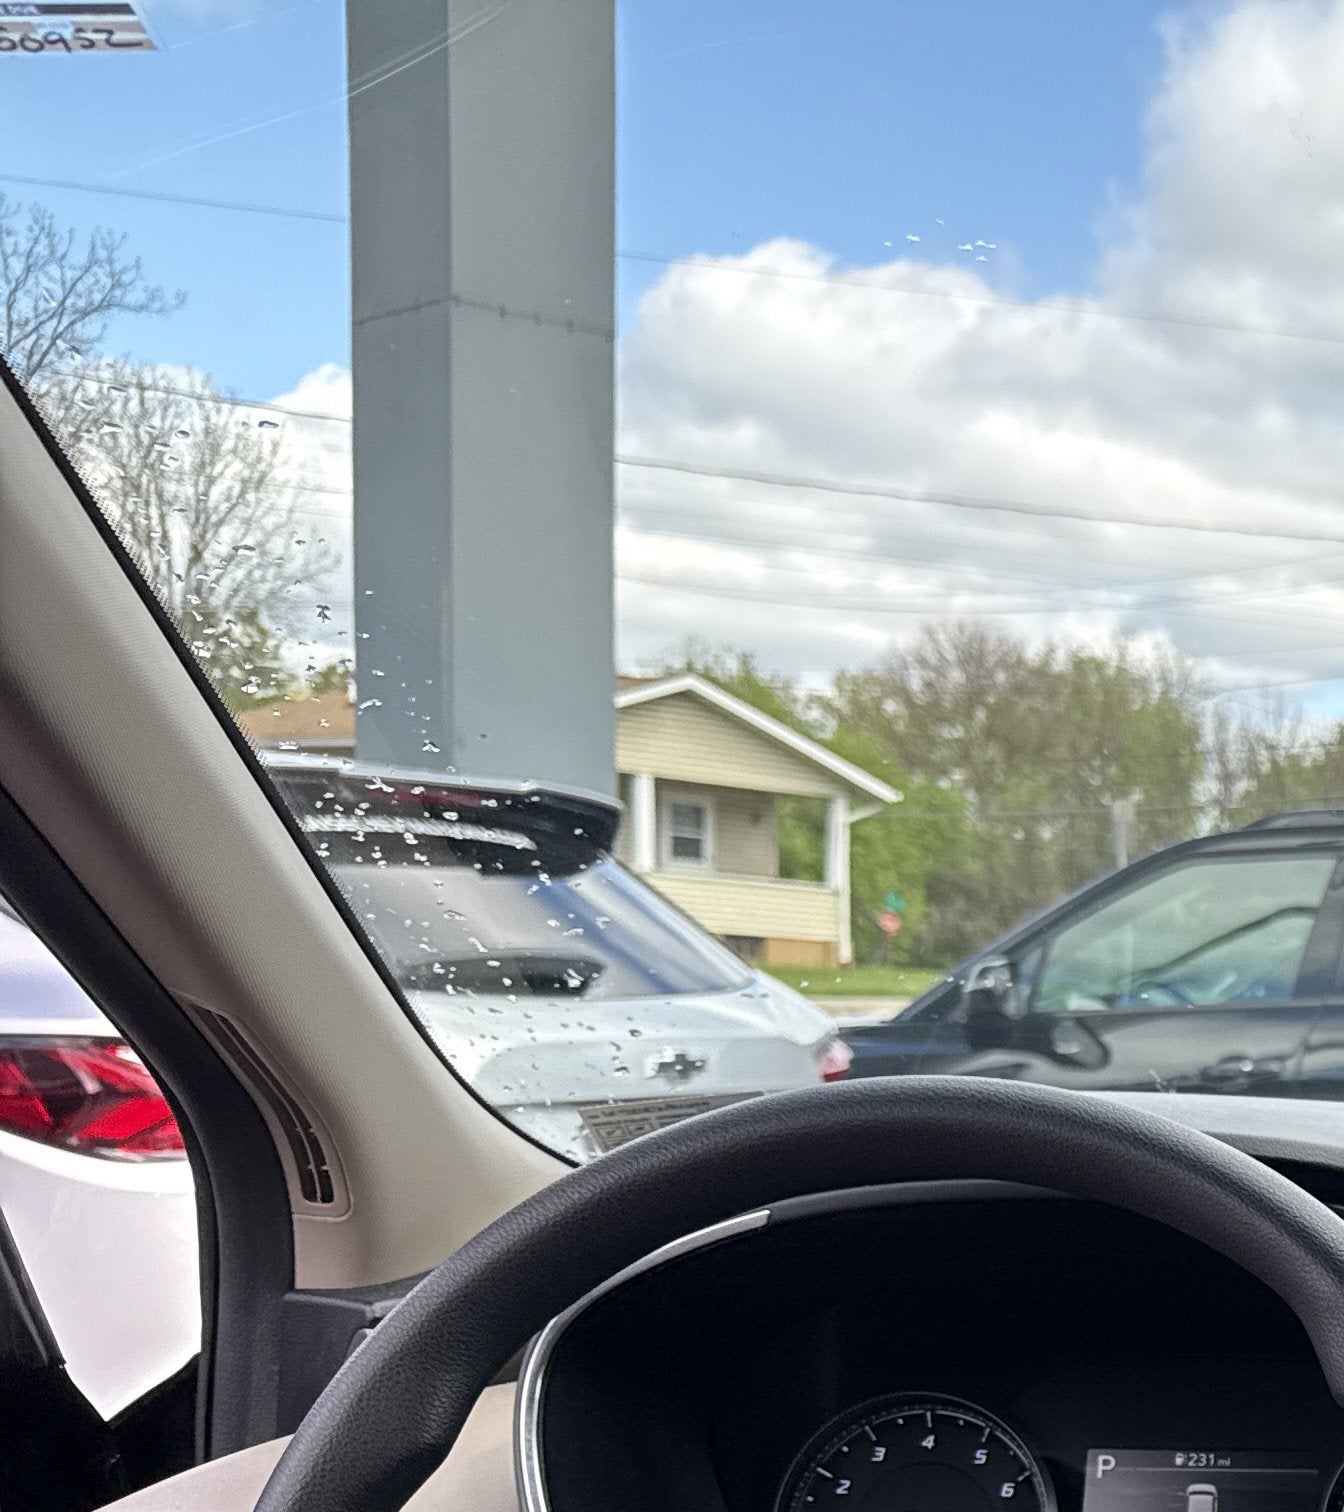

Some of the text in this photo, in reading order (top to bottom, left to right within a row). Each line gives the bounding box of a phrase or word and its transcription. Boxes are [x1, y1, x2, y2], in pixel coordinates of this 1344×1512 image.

[921, 1435, 936, 1450] 4
[871, 1447, 886, 1462] 3
[974, 1449, 988, 1464] 5
[1188, 1453, 1231, 1467] 231 mi
[1096, 1455, 1116, 1479] P
[835, 1480, 851, 1495] 2
[1001, 1482, 1015, 1498] 6
